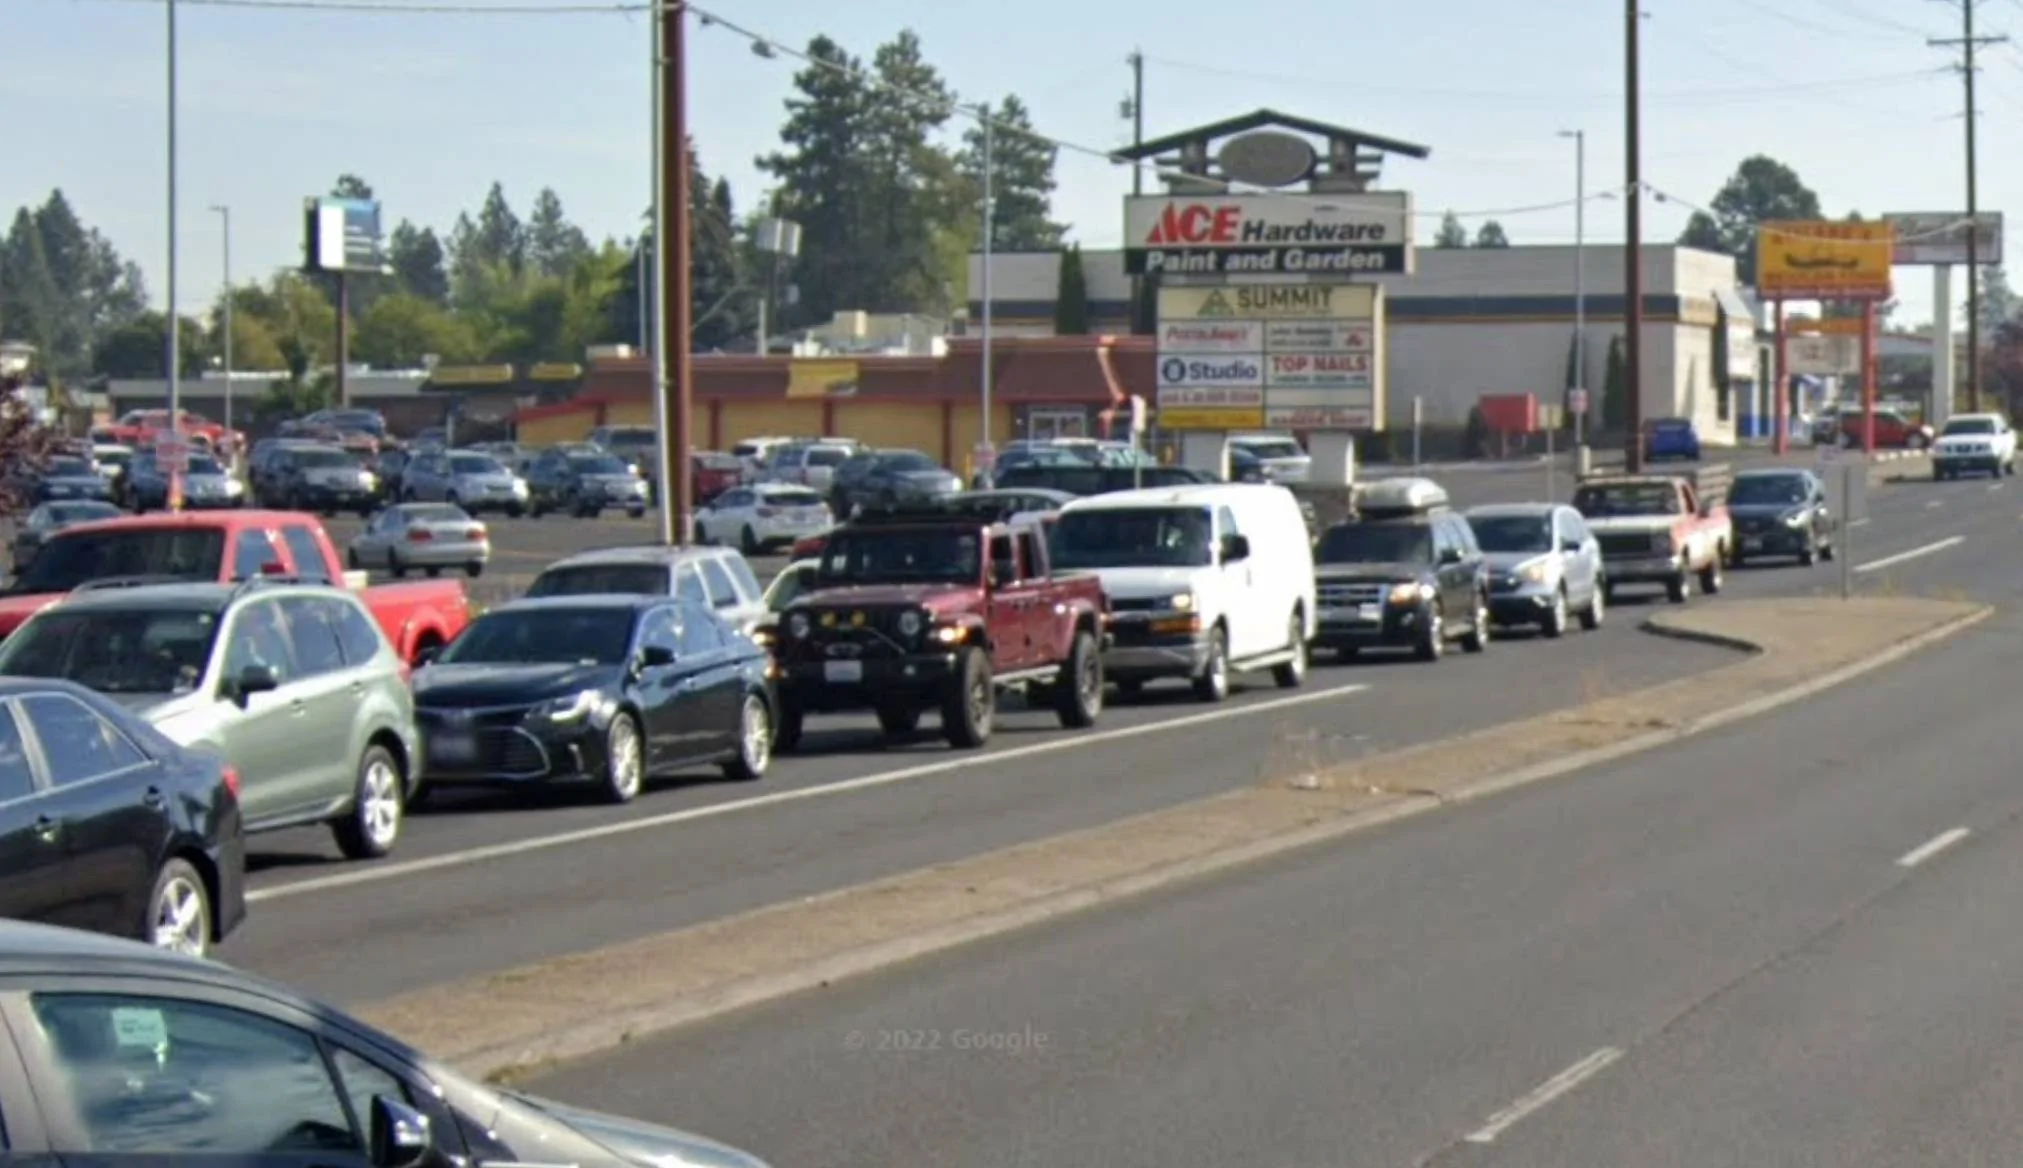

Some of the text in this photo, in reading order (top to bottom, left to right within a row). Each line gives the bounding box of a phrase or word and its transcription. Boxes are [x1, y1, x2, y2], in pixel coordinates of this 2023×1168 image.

[1146, 201, 1384, 242] ACE Hardware
[1146, 248, 1385, 271] Paint and Garden
[1237, 285, 1332, 308] SUMMIT
[1190, 361, 1257, 380] Studio
[1272, 355, 1367, 373] TOP NAILS
